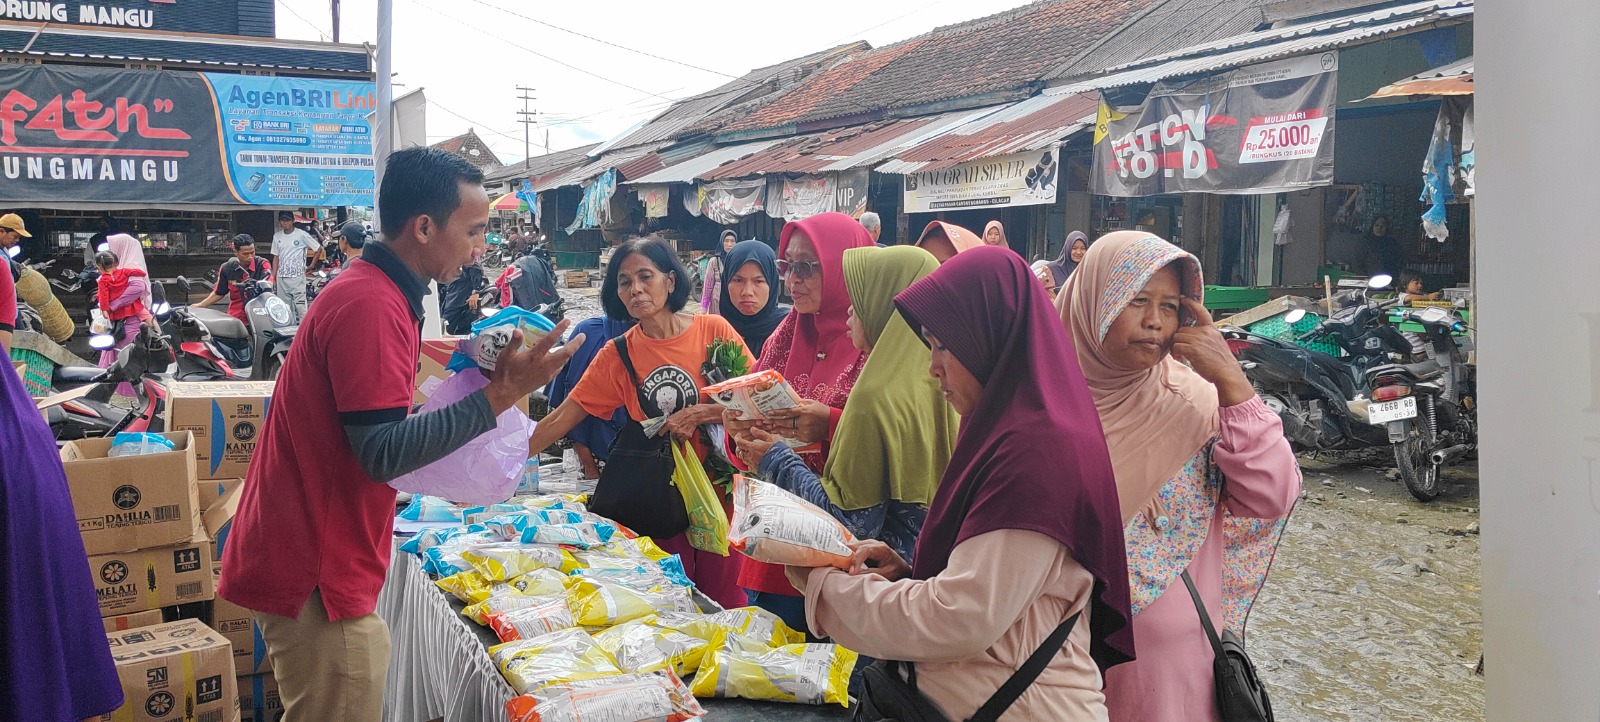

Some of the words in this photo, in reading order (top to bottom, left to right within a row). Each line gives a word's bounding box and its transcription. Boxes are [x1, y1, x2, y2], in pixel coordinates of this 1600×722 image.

[79, 5, 154, 28] MANGU
[262, 108, 297, 117] Transaksi
[299, 110, 334, 120] Keuangan
[1264, 114, 1286, 124] MULAI
[1287, 112, 1306, 121] DARI
[980, 160, 1025, 182] SILVER
[838, 188, 854, 206] VIP
[1380, 402, 1398, 412] 4668
[1404, 399, 1413, 408] RB
[105, 510, 151, 524] DAHLIA
[764, 506, 774, 535] DAHLIA
[96, 583, 136, 596] MELATI
[147, 667, 168, 682] SNI
